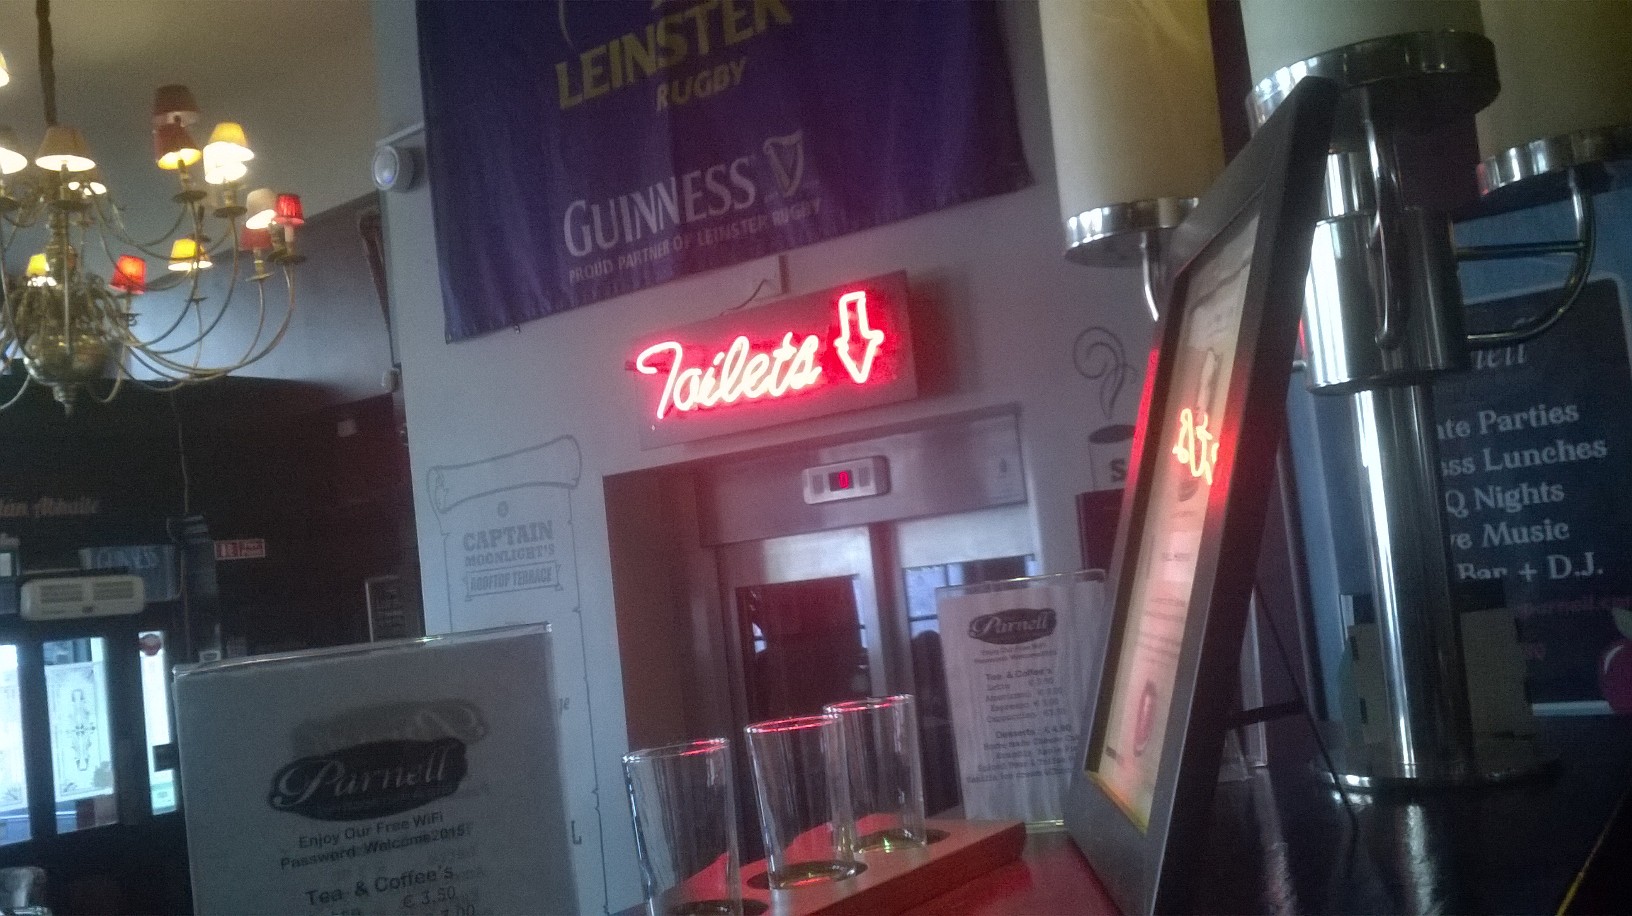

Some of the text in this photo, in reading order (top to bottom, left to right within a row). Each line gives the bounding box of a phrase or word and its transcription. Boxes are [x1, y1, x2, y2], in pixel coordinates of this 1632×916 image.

[555, 0, 792, 110] LEINSTER
[656, 59, 748, 111] RUGBY
[564, 156, 757, 257] GUINNESS
[569, 260, 613, 284] PROUD
[619, 240, 670, 270] PARTNER
[636, 332, 823, 420] Toilets
[1478, 404, 1580, 435] Parties
[1484, 439, 1608, 471] Lunches
[1474, 482, 1565, 514] Nights
[463, 520, 553, 551] CAPTAIN
[1481, 518, 1570, 548] Music
[464, 543, 555, 567] MOONLIGHT'S
[1547, 551, 1605, 580] D.J.
[470, 572, 510, 592] ROOFTOP
[971, 611, 1048, 636] Parnell
[270, 744, 450, 808] Parnell
[299, 811, 445, 849] Enjoy Our Free WiFi
[305, 865, 455, 906] Tea & Coffee's
